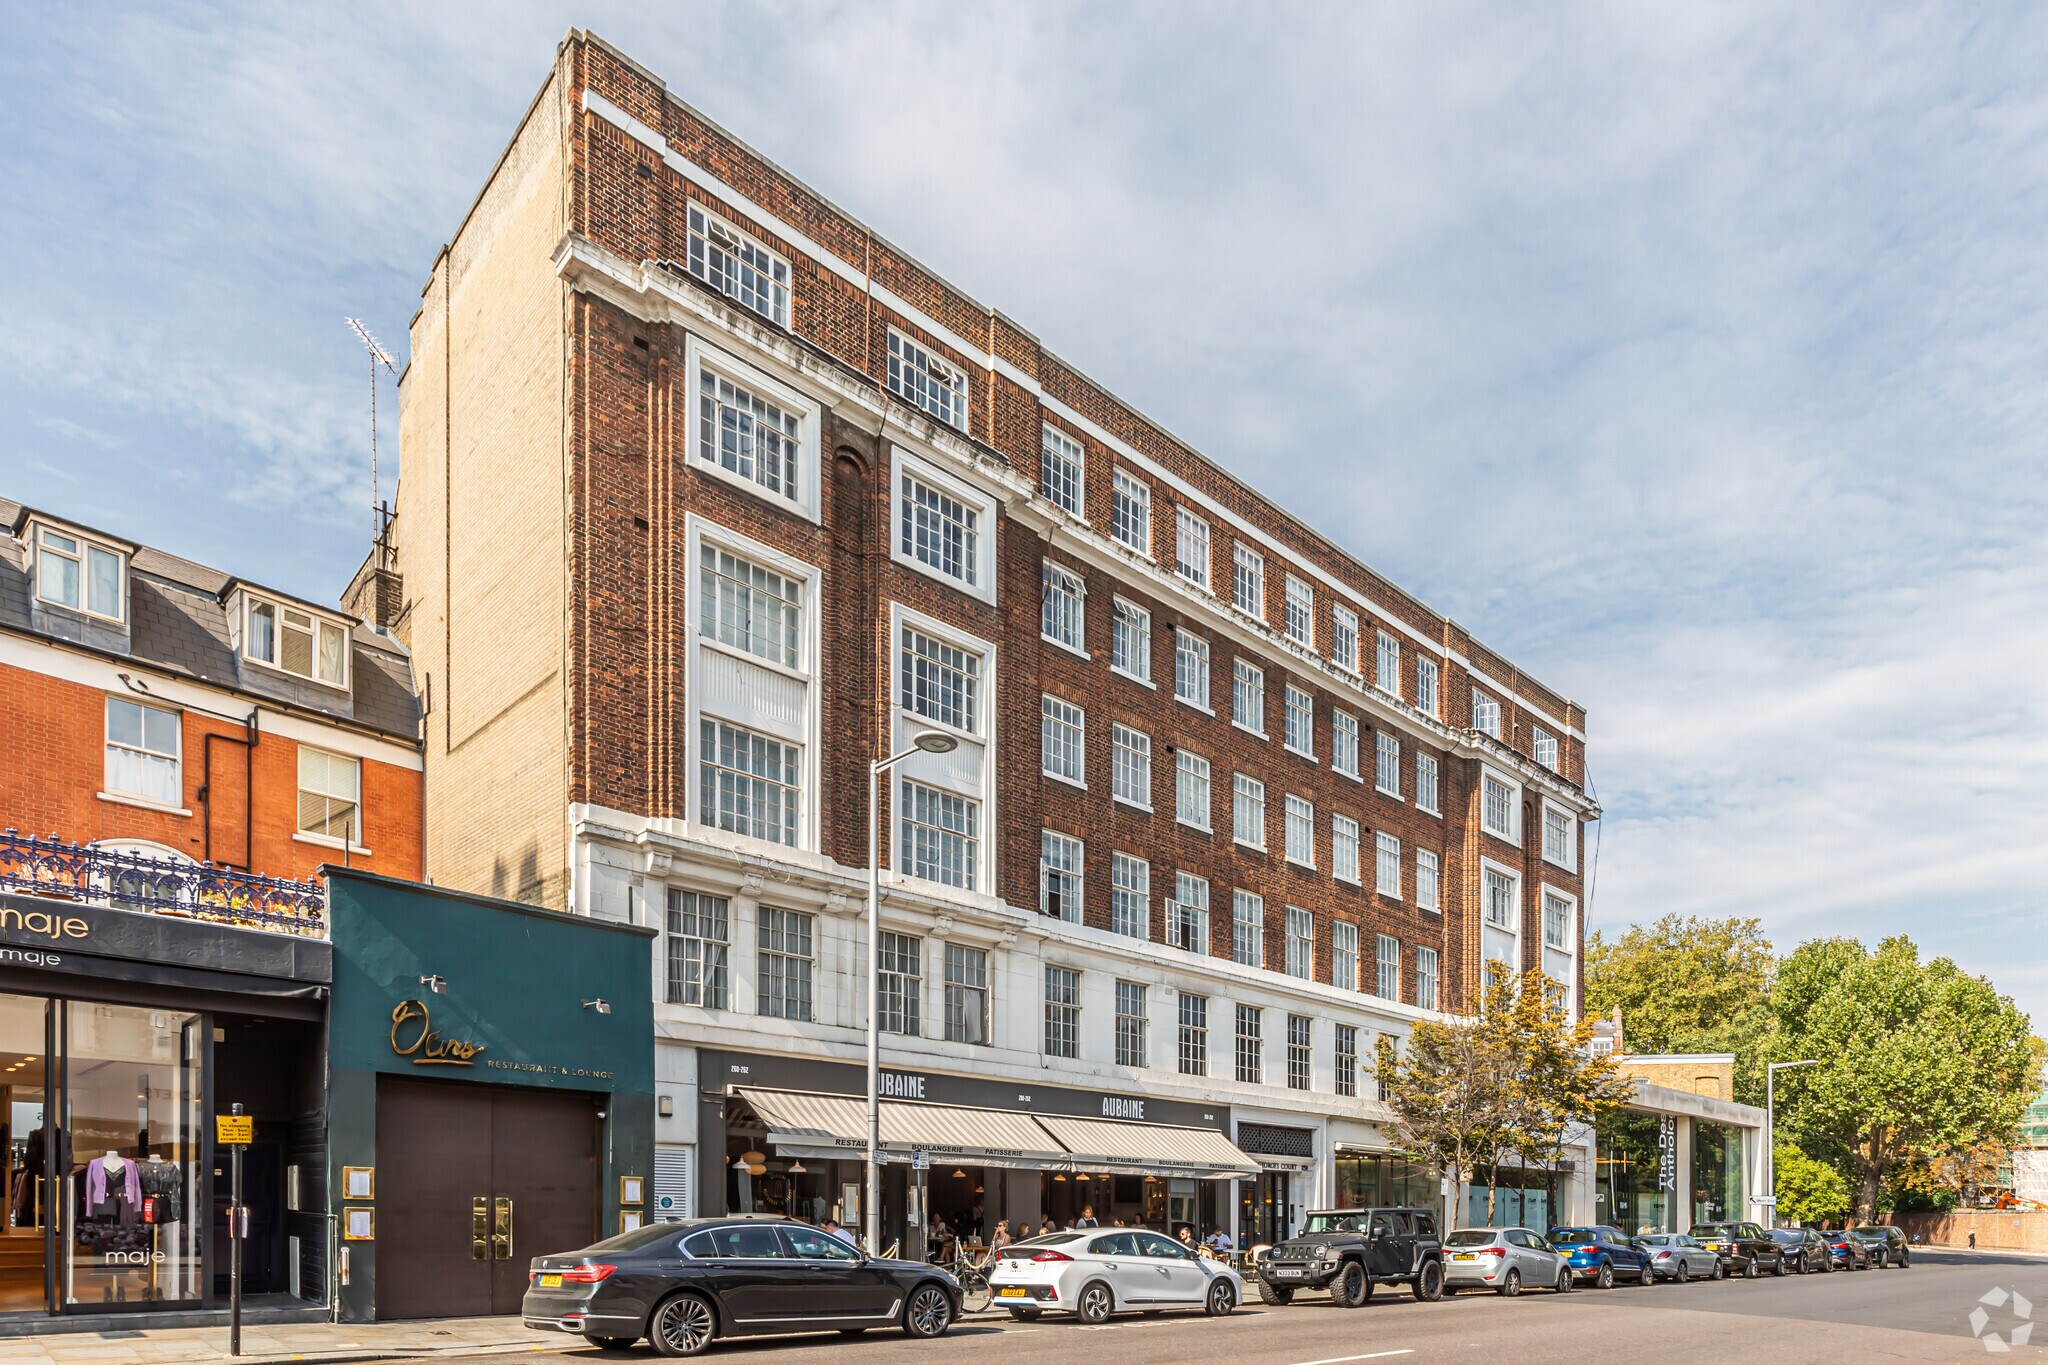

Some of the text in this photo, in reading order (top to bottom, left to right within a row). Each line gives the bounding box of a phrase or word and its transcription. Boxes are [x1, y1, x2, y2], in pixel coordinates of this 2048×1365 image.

[0, 949, 61, 966] maje
[487, 1060, 614, 1079] RESTAURANT & LOUNGE
[730, 1064, 749, 1074] 260-262
[877, 1072, 925, 1099] UBAINE
[1102, 1096, 1144, 1119] AUBAINE
[835, 1138, 1023, 1157] RESTAUNT BOULANGERIE PATISSERIE
[1106, 1156, 1142, 1164] RESTAURANT
[1158, 1160, 1195, 1168] BOULANGERIE
[1658, 1154, 1666, 1190] The
[105, 1248, 166, 1266] maje
